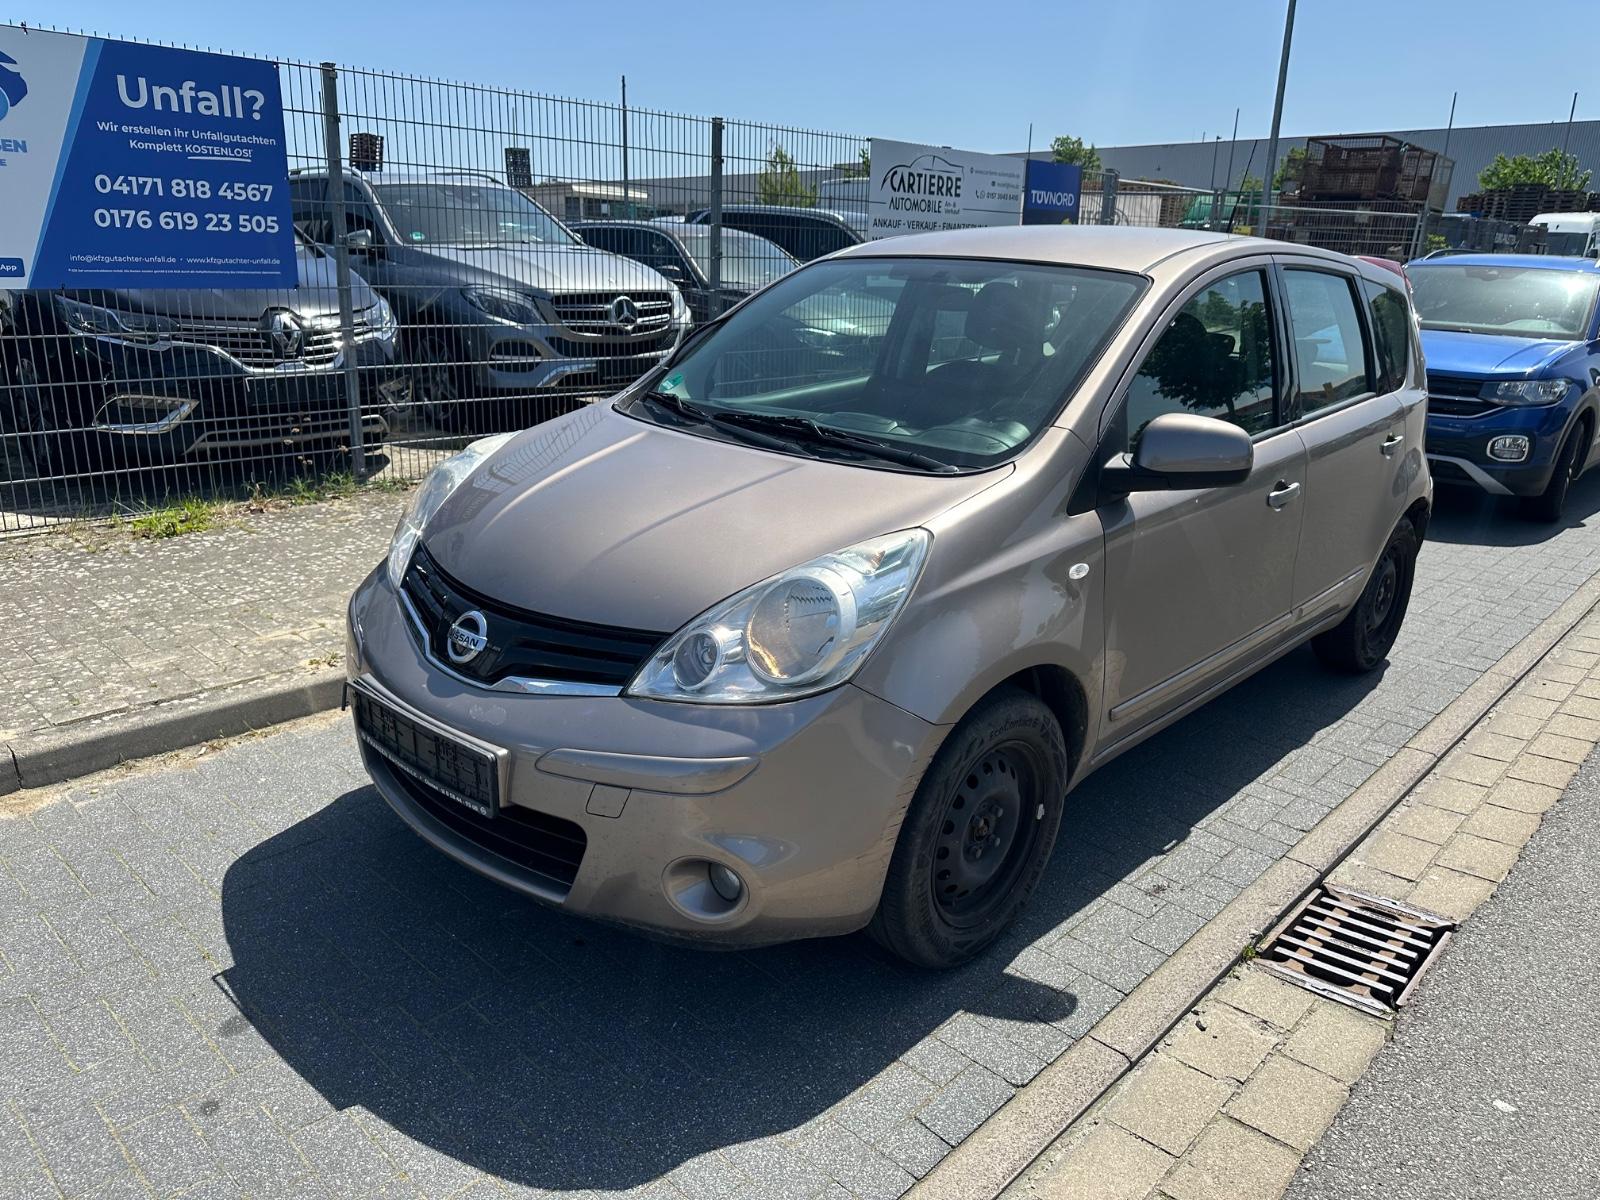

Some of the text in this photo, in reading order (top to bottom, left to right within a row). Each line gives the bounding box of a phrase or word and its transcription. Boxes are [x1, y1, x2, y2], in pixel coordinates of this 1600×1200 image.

[116, 74, 265, 121] Unfall?
[97, 121, 276, 146] Wir erstellen ihr Unfallgutachten
[0, 138, 28, 153] EN
[129, 139, 183, 154] Komplett
[94, 174, 273, 202] 04171 818 4567
[889, 170, 962, 197] CARTIERRE
[889, 197, 942, 214] AUTOMOBILE
[93, 209, 279, 233] 0176 619 23 505
[872, 218, 902, 229] ANKAUF
[907, 220, 938, 231] VERKAUF
[70, 254, 281, 266] info@kfzgutachter-unfall.de www.kfzgutachter-unfall.de
[448, 627, 479, 647] NISSAN
